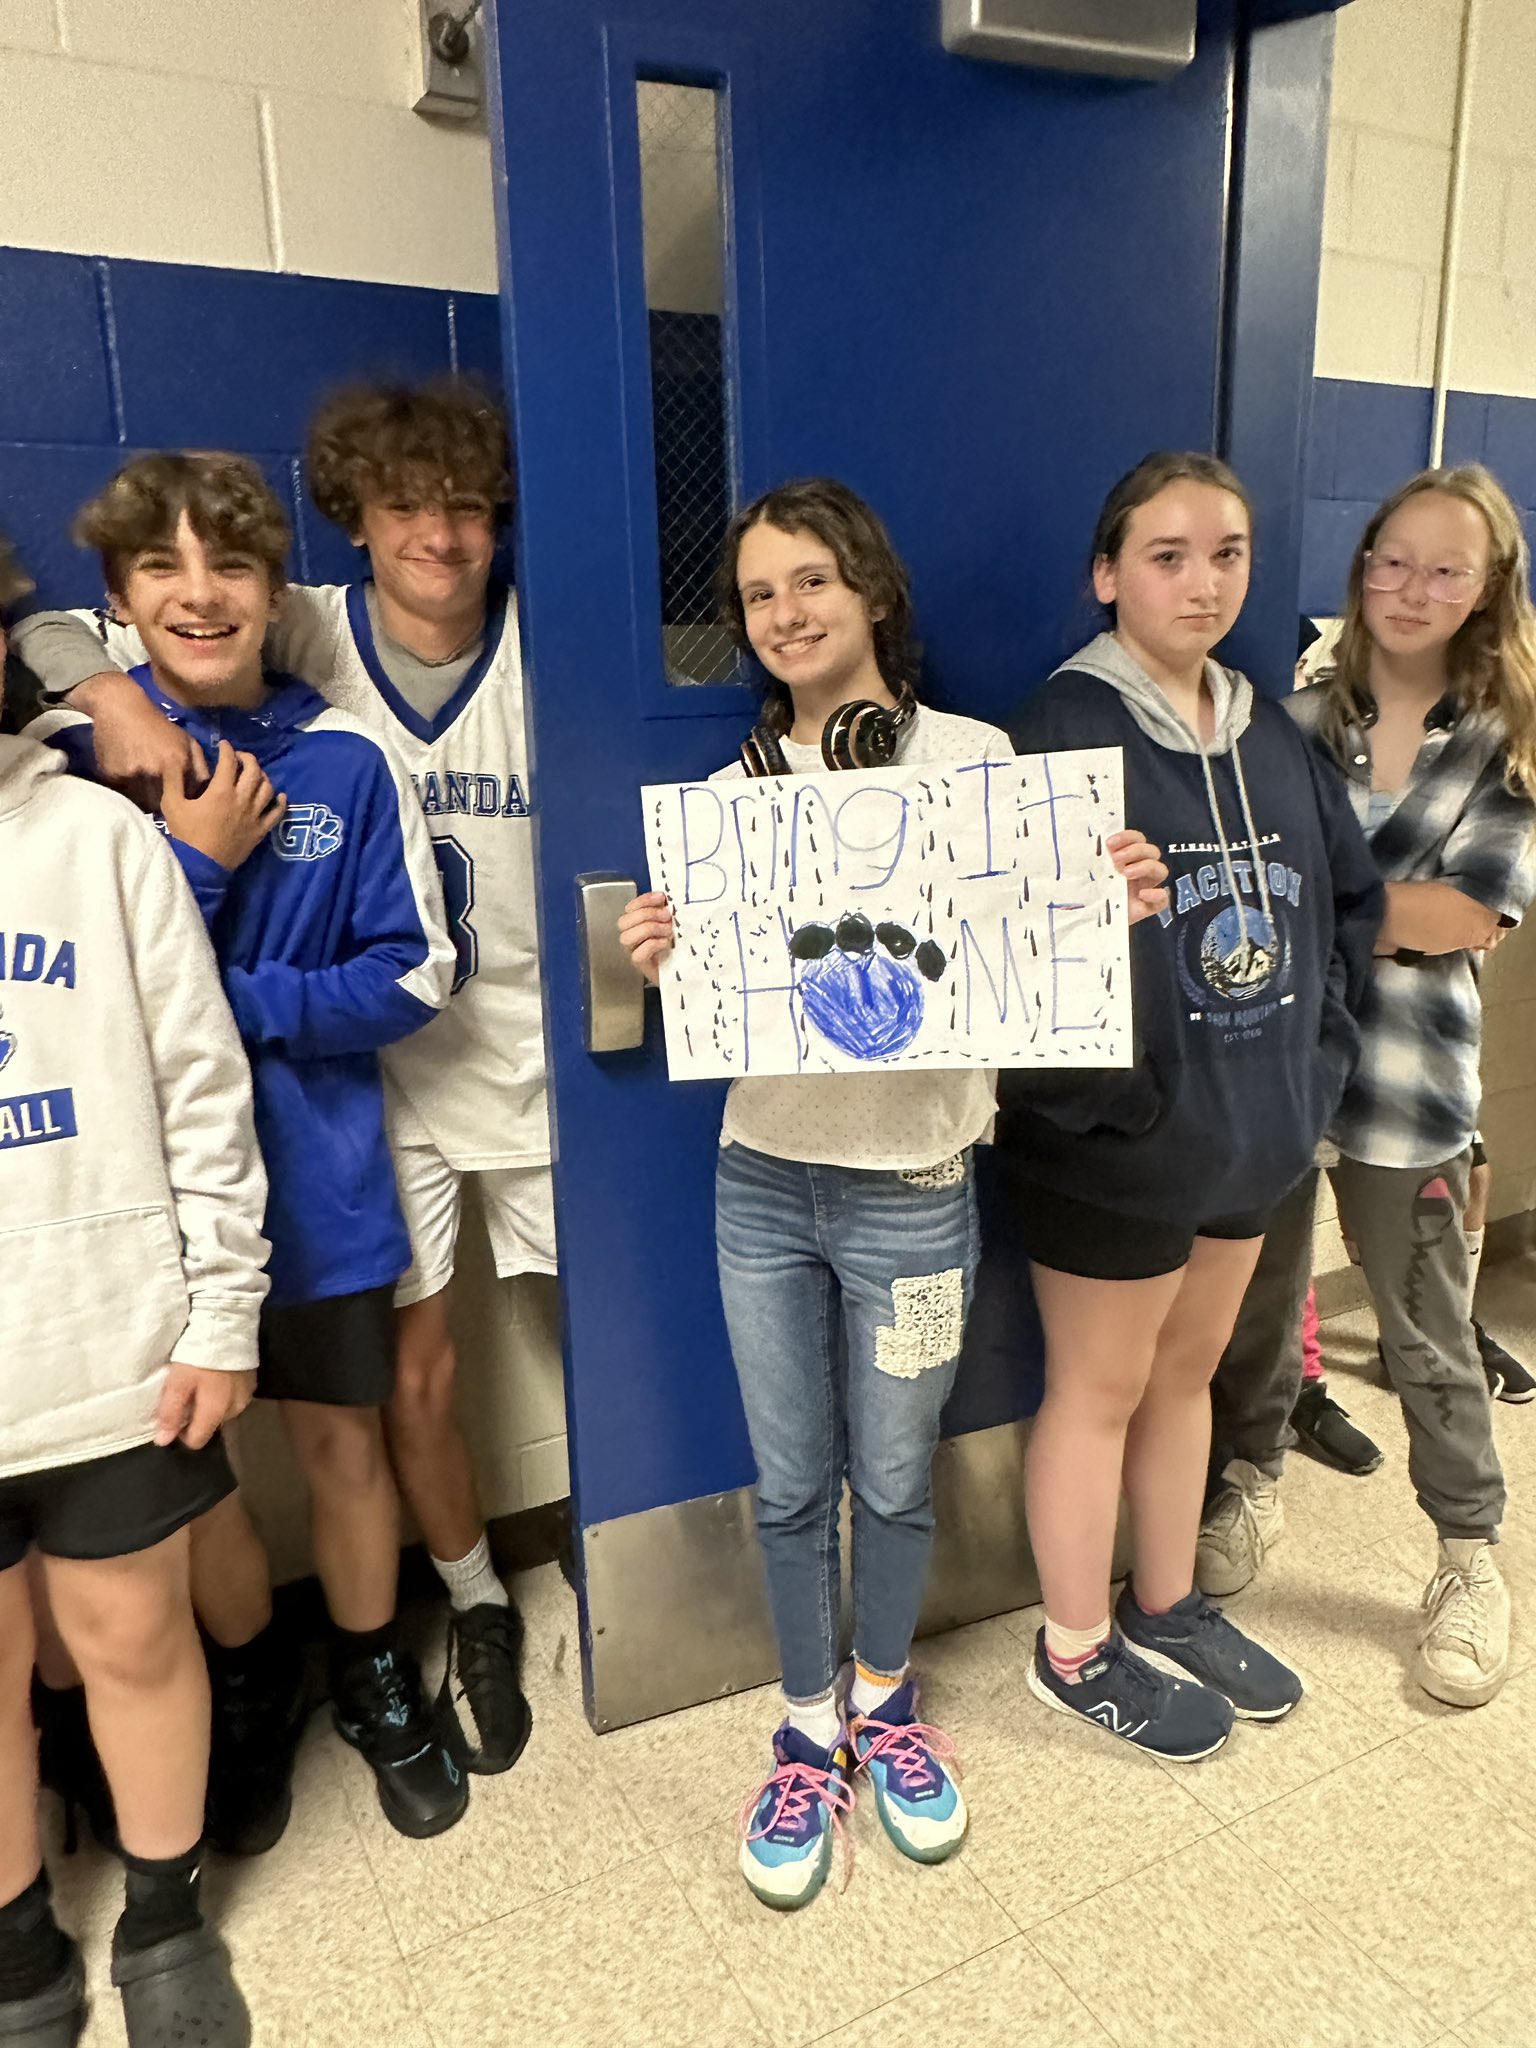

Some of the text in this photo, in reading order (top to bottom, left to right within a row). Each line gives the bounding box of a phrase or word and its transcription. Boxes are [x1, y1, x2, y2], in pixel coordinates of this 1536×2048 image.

[410, 771, 531, 818] ANDA
[680, 784, 909, 904] Bring
[0, 932, 76, 989] DA
